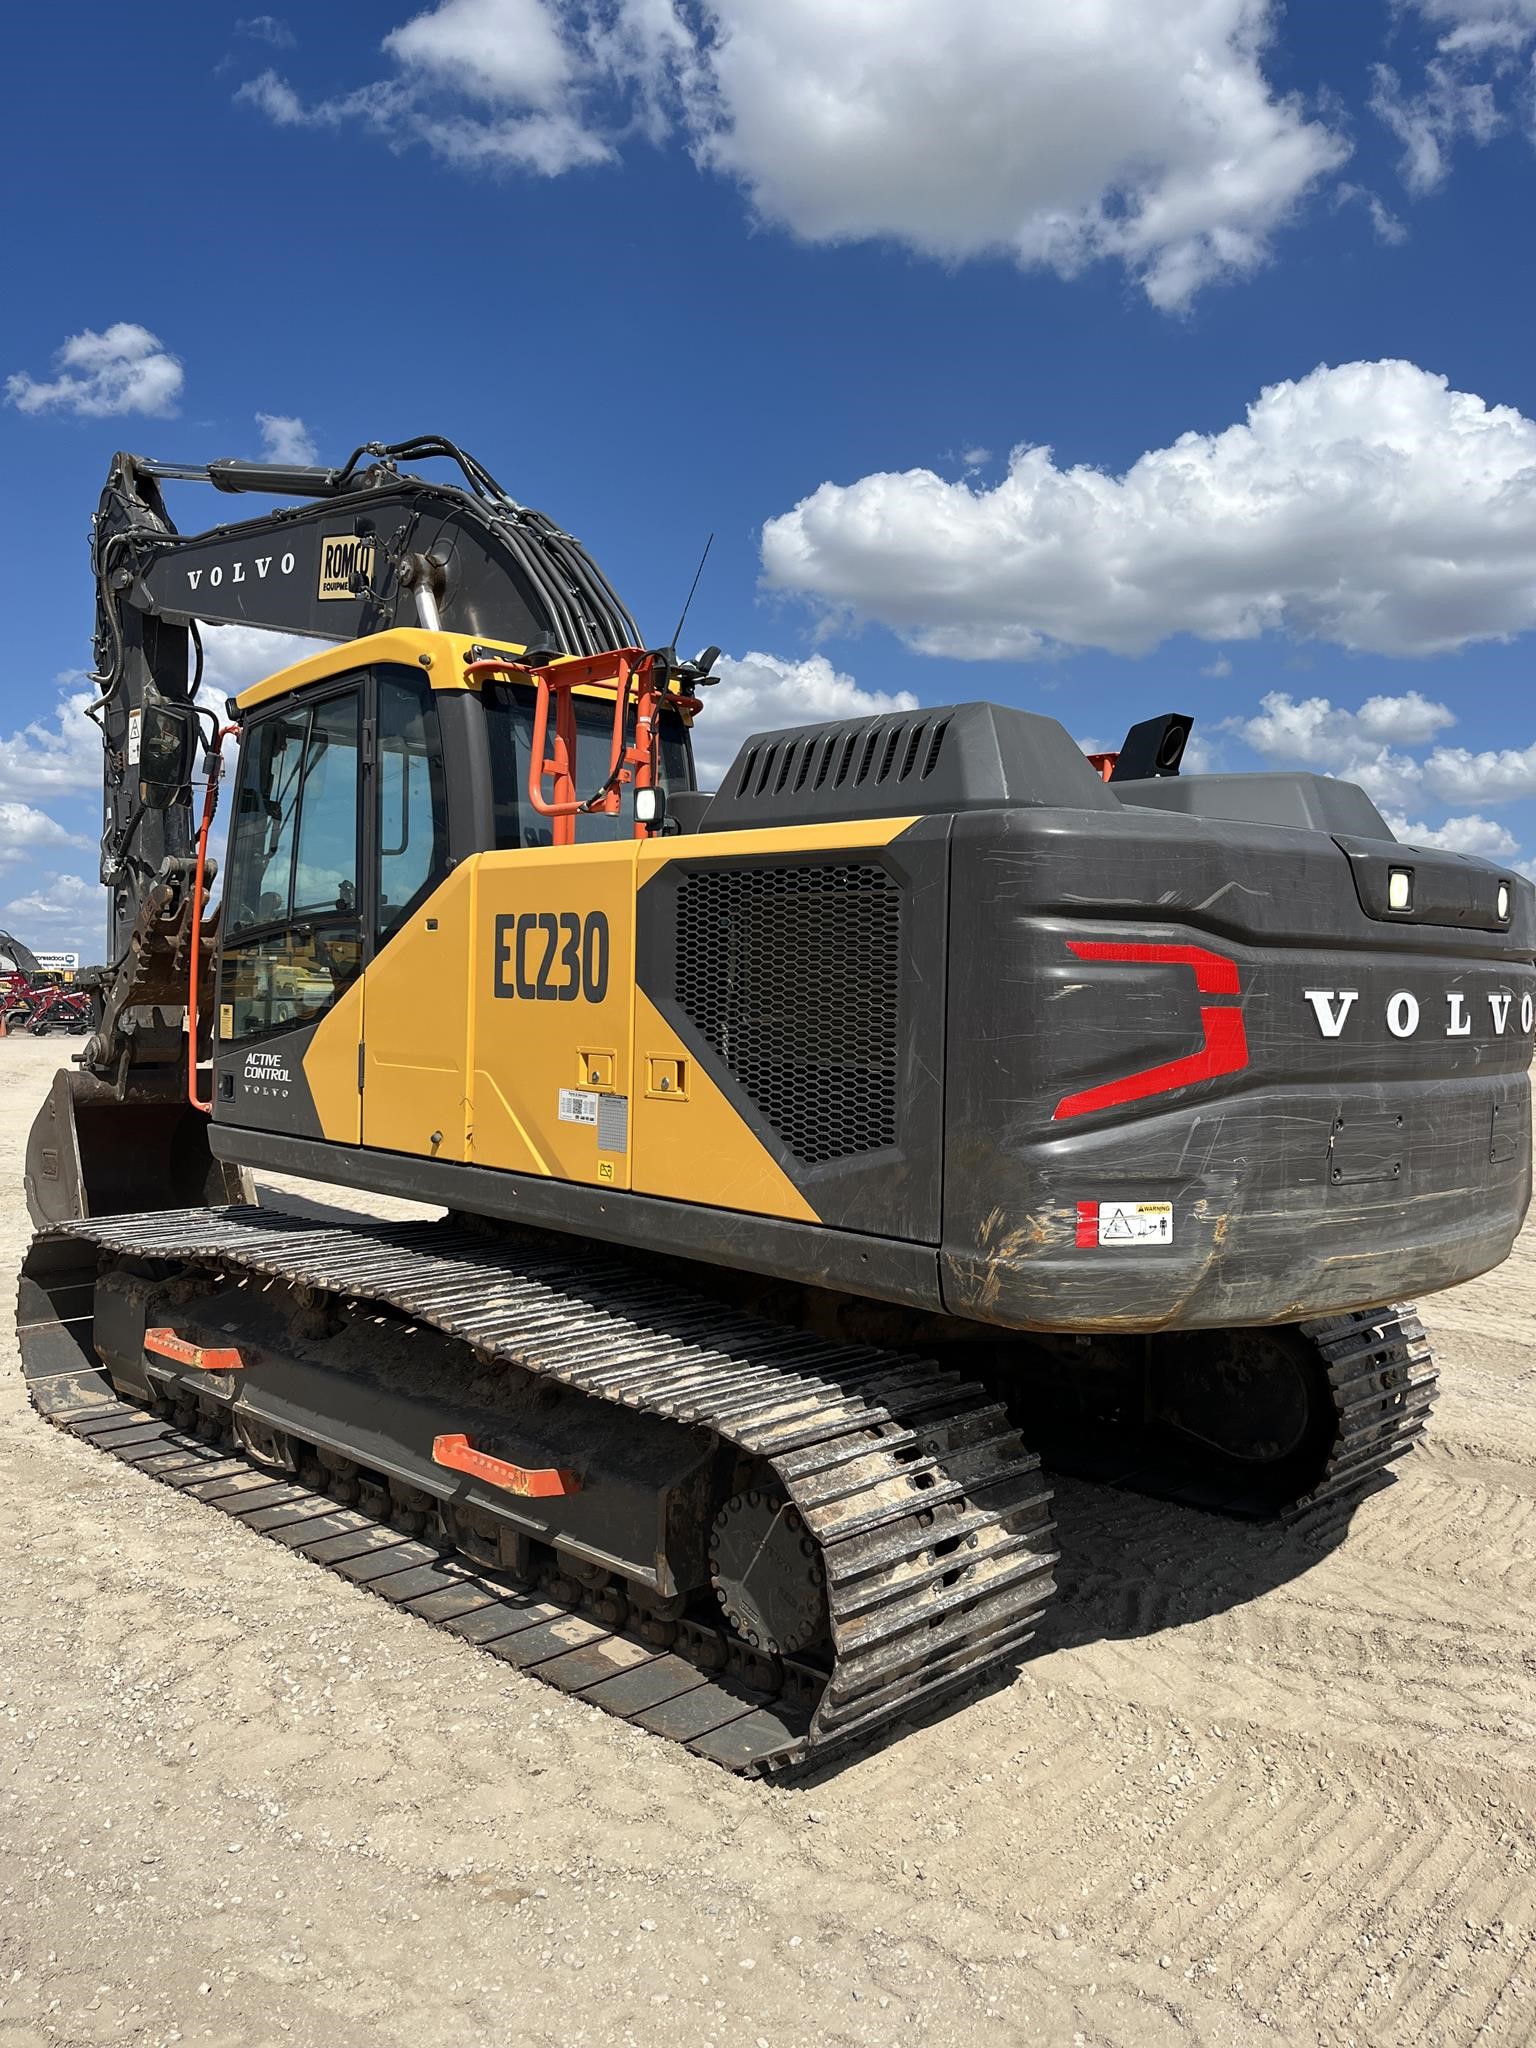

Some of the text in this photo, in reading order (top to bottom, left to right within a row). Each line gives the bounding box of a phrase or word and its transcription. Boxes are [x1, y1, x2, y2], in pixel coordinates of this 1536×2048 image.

[187, 553, 295, 590] VOLVO
[324, 543, 370, 579] ROMCO
[323, 582, 348, 591] EQUIPME
[494, 911, 609, 1003] EC230
[1304, 991, 1533, 1037] VOLVO
[245, 1053, 282, 1066] ACTIVE
[244, 1066, 292, 1082] CONTROL
[243, 1085, 289, 1098] VOLVO
